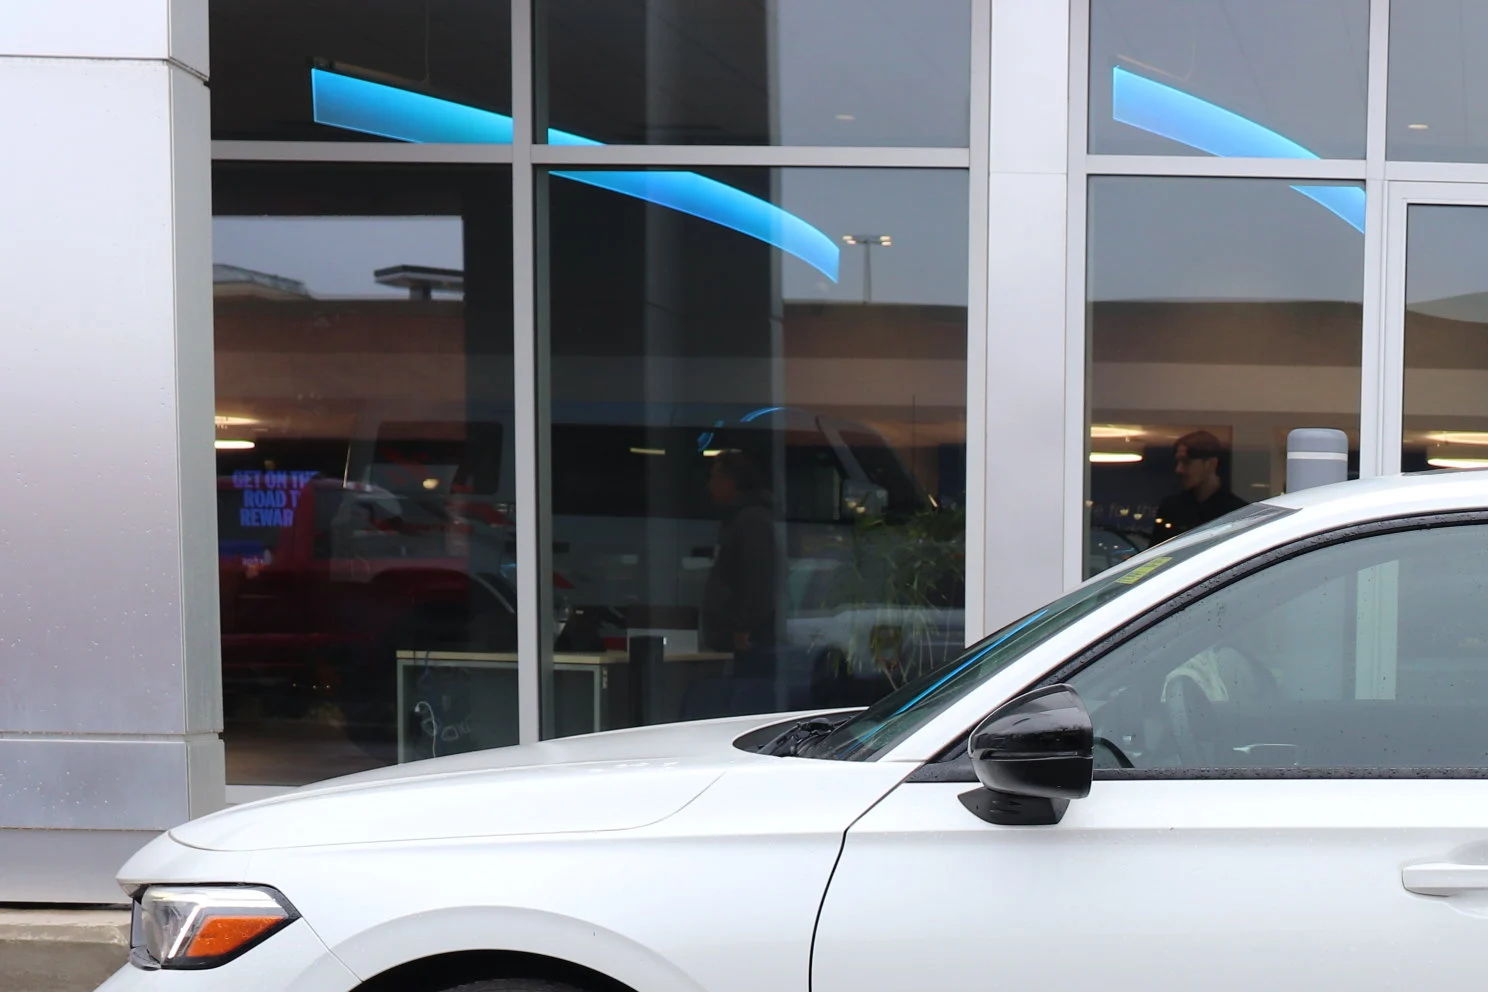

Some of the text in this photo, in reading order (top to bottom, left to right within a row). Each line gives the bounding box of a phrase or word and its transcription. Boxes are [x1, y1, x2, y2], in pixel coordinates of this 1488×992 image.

[232, 469, 262, 489] GET
[264, 469, 287, 489] ON
[243, 490, 302, 508] ROAD T
[240, 508, 294, 527] REWAR
